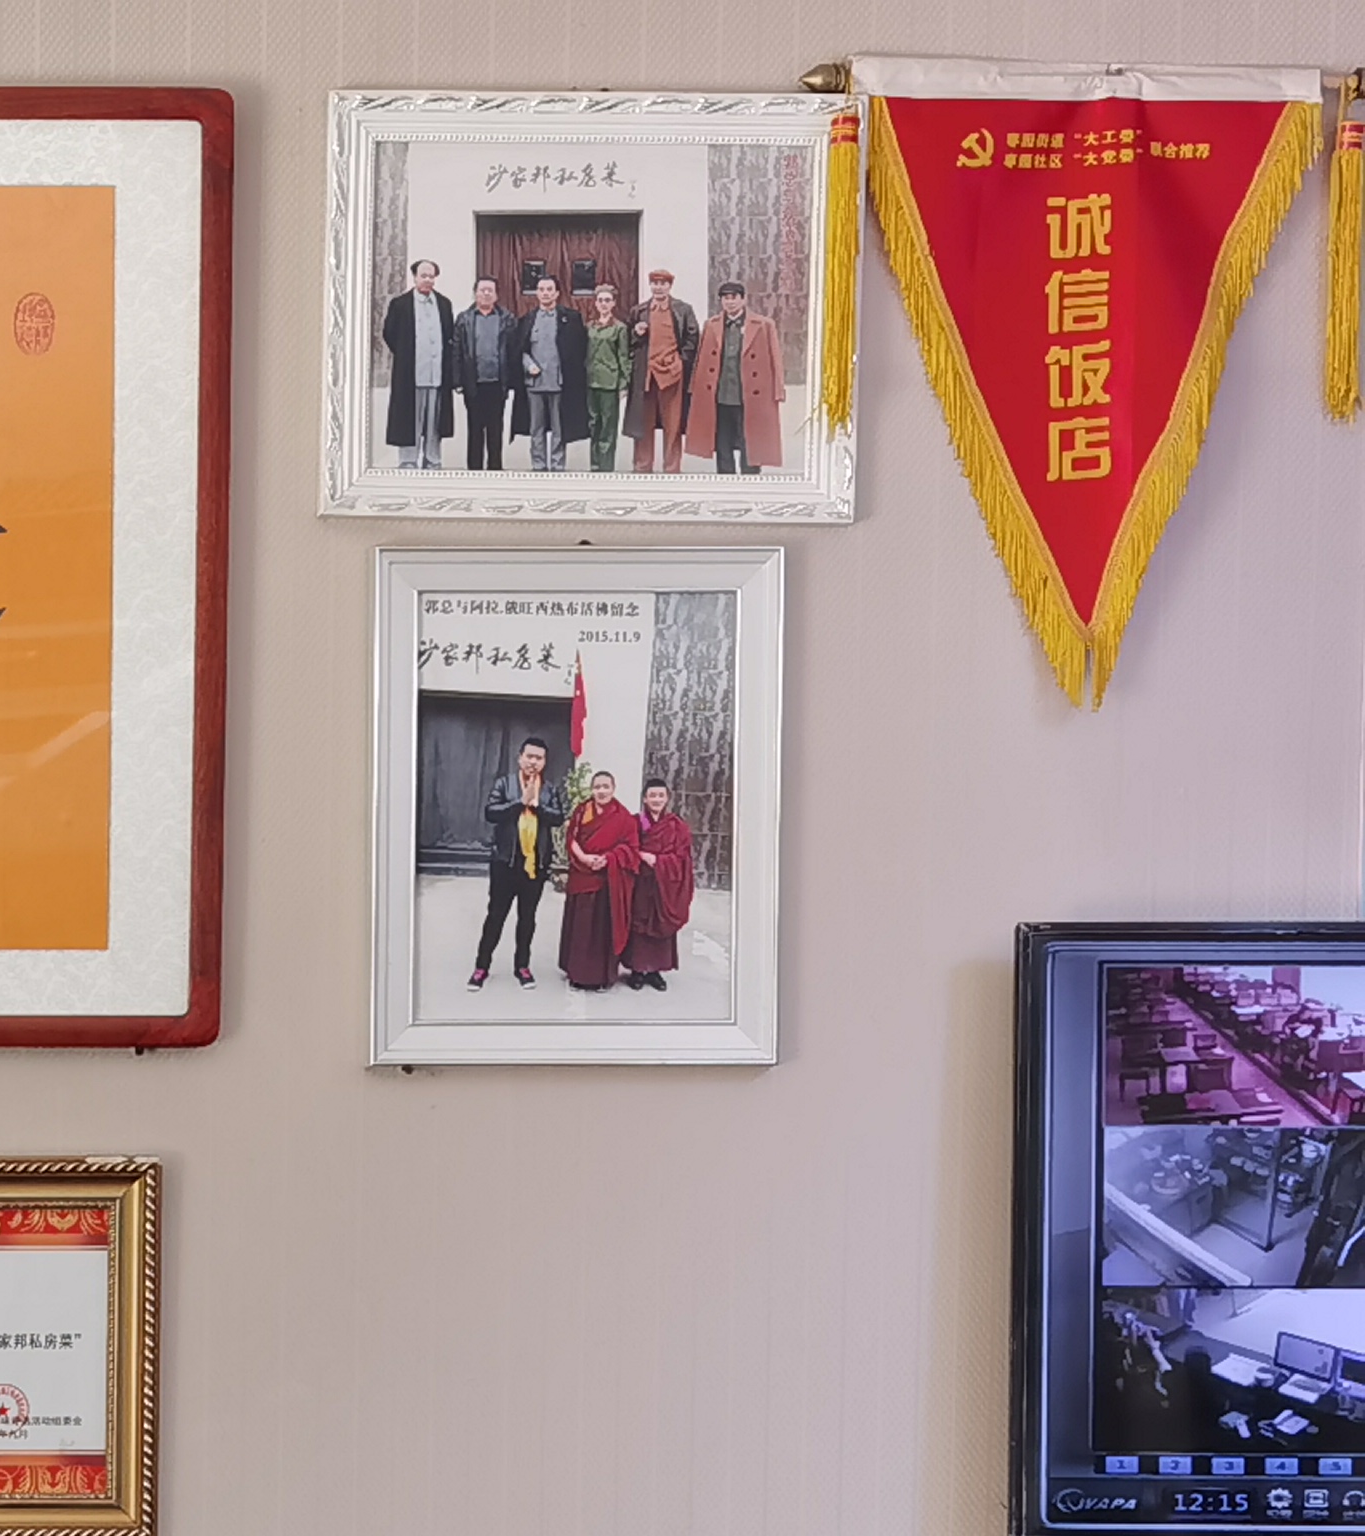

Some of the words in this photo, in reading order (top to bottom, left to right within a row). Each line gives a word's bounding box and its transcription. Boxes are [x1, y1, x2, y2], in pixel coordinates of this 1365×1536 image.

[1044, 193, 1112, 482] 诚信饭店
[578, 631, 641, 643] 2015.11.9
[1174, 1493, 1249, 1511] 12:15
